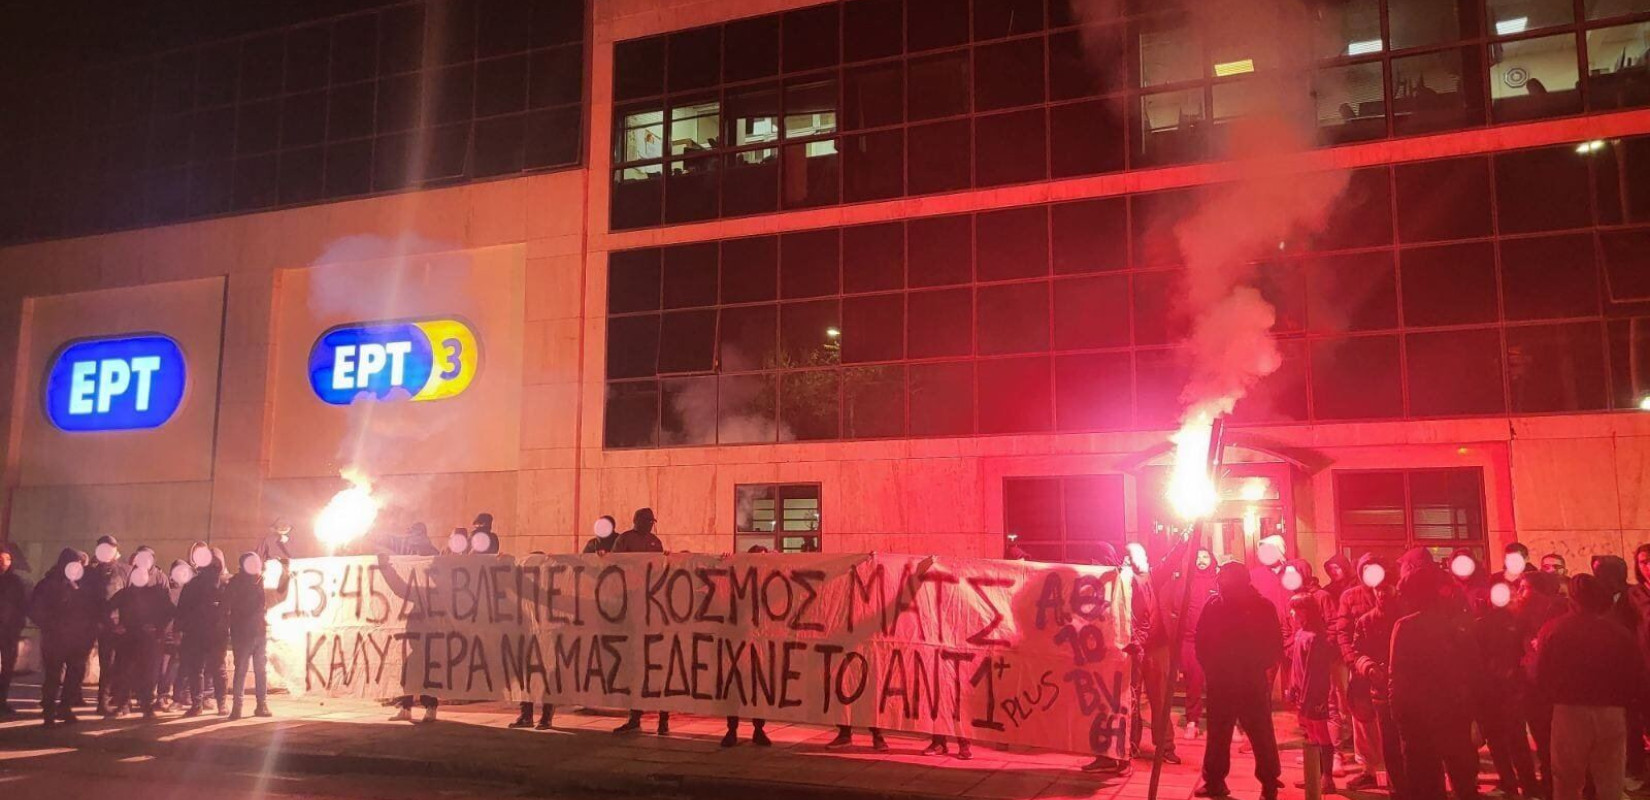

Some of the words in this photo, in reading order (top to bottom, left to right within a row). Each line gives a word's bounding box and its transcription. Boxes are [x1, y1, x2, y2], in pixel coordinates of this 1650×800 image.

[69, 356, 160, 415] ΕΡΤ
[333, 341, 412, 389] ΕΡΤ
[440, 338, 462, 379] 3
[282, 564, 391, 624] 13:45
[452, 564, 585, 626] ΒΛΕΠΕΙ
[596, 565, 628, 623] Ο
[645, 562, 826, 632] ΚΟΣΜΟΣ
[305, 631, 493, 692] ΚΑΛΥΤΕΡΑ
[502, 633, 551, 695] ΝΑ
[554, 633, 632, 695] ΜΑΣ
[641, 632, 807, 709] ΕΔΕΙΧΝΕ
[814, 644, 868, 714] ΤΟ
[1002, 670, 1059, 727] PLUS
